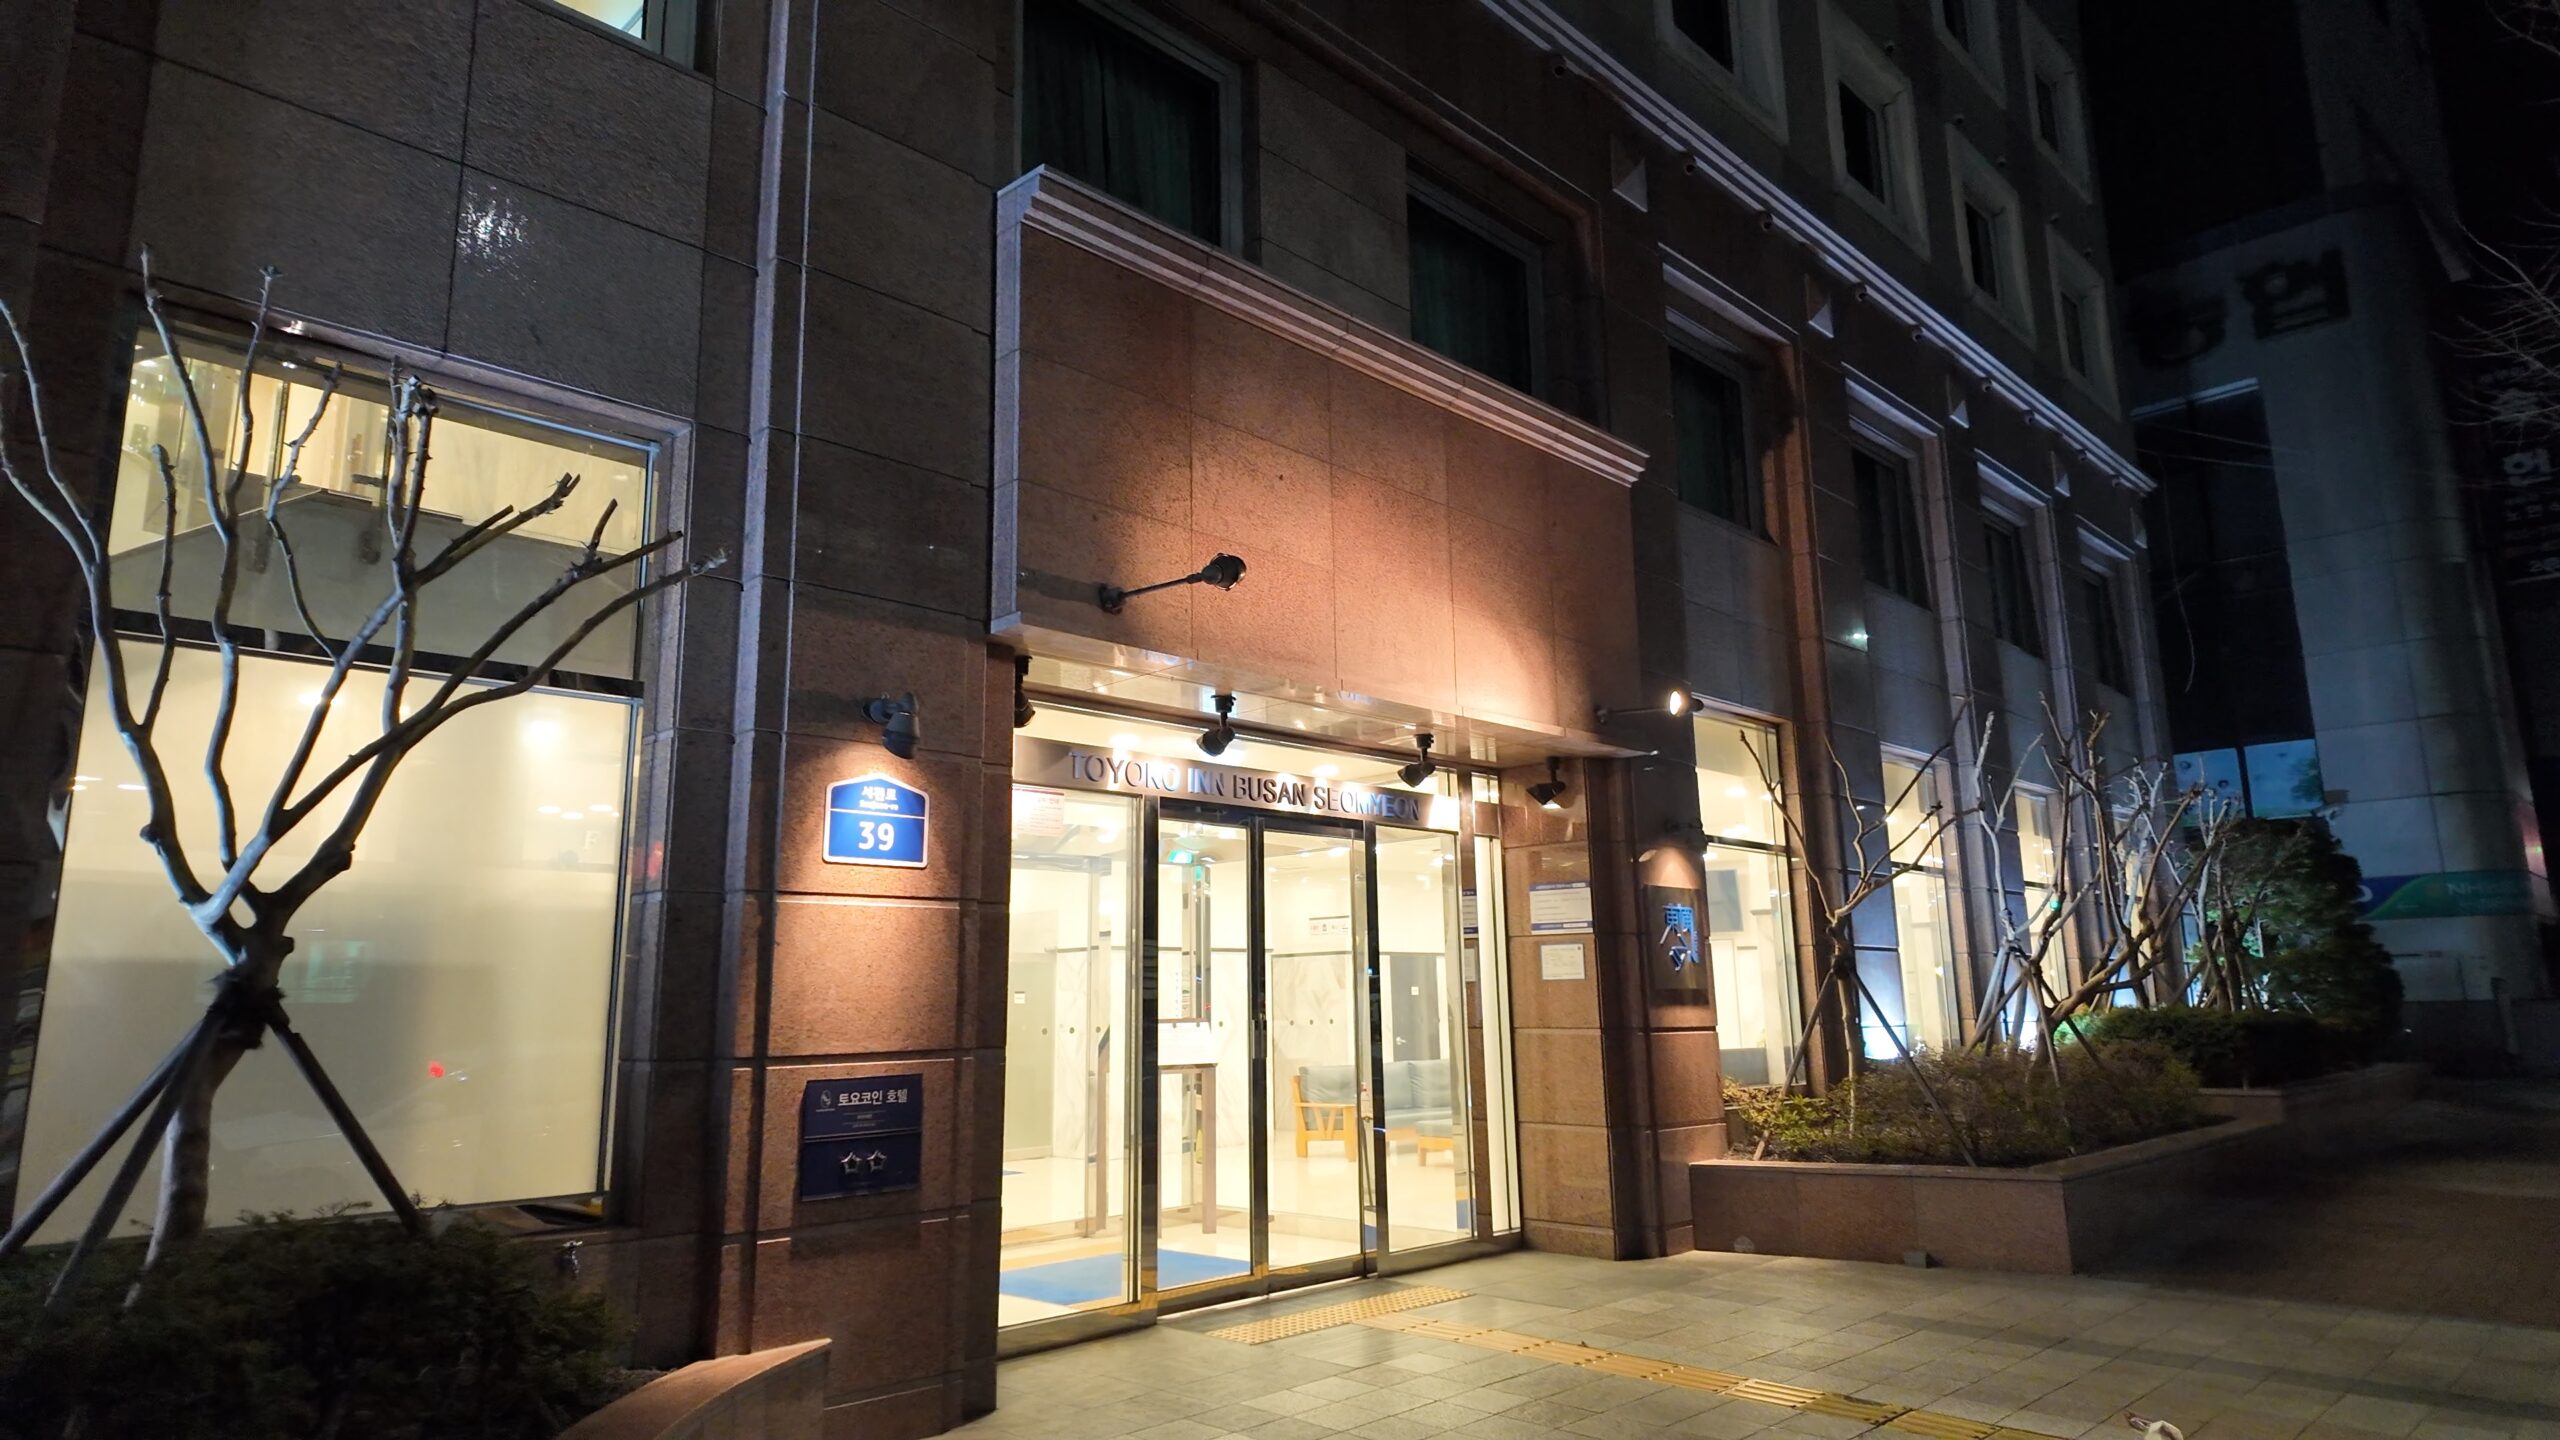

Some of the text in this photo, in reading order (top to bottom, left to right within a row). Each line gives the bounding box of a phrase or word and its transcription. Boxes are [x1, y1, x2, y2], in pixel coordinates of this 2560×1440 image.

[1069, 751, 1420, 821] TOYOKO INN BUSAN SEOMYEON
[858, 821, 895, 851] 39
[838, 1088, 908, 1106] 토요코인 호텔
